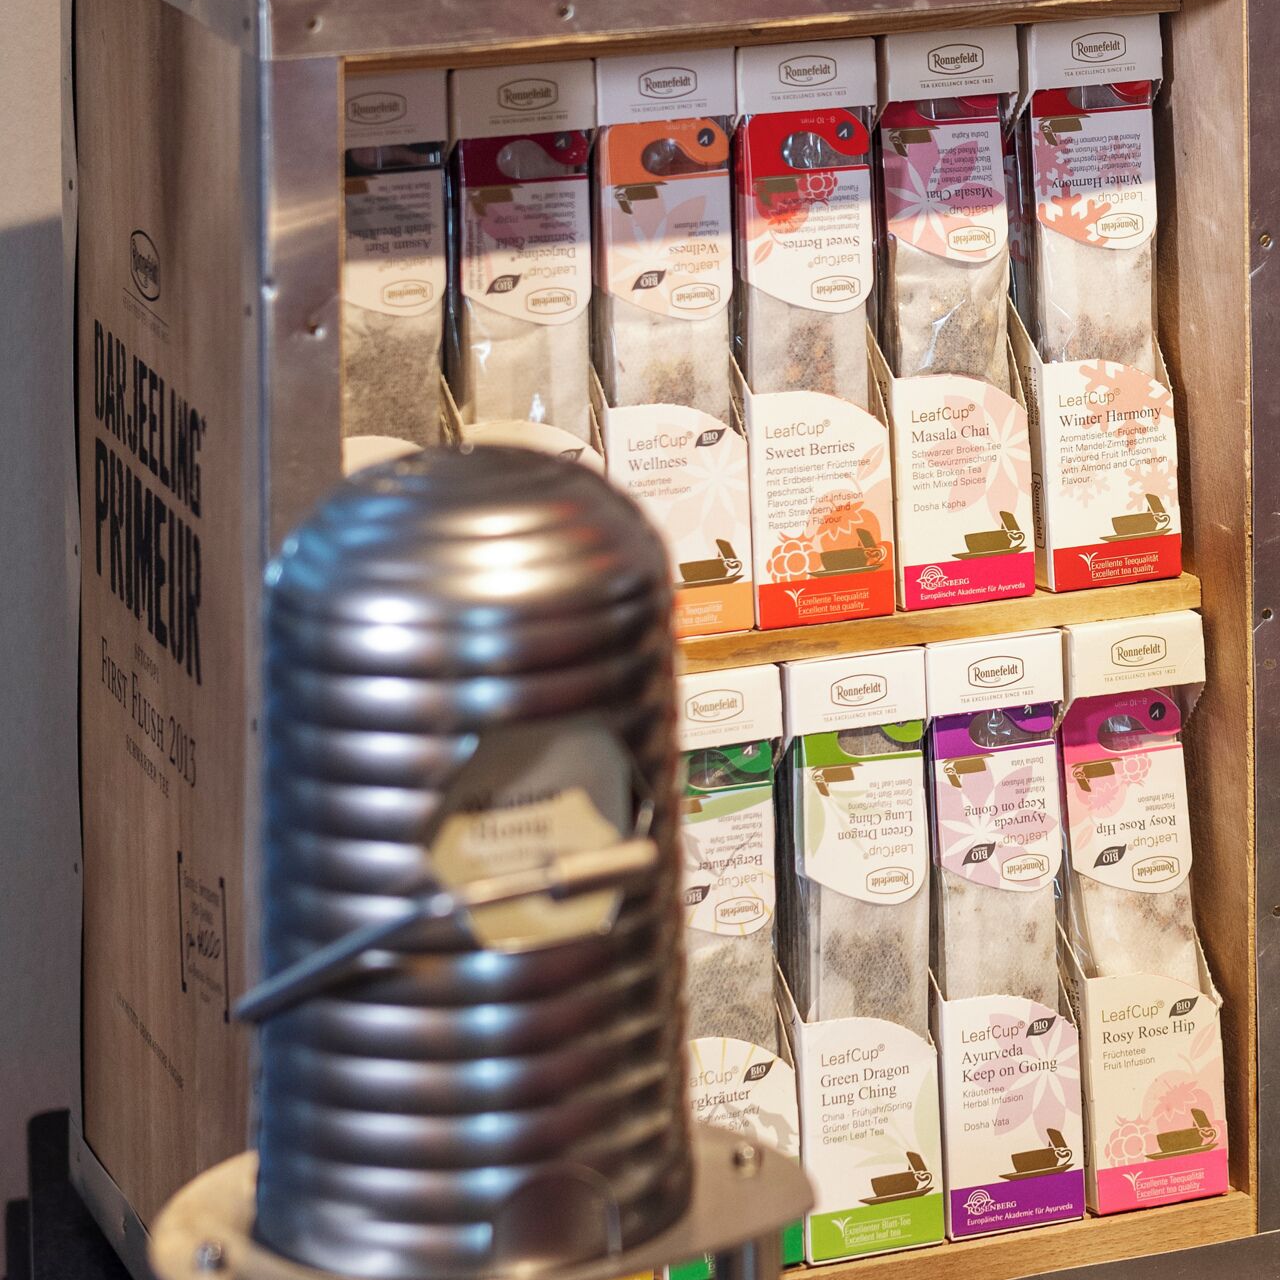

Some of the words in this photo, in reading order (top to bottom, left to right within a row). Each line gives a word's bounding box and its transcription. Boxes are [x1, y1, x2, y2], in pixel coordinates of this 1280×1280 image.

[1076, 41, 1120, 56] Ronnefeldt
[934, 52, 978, 68] Ronnefeldt
[784, 63, 831, 79] Ronnefeldt
[645, 77, 691, 91] Ronnefeldt
[1052, 177, 1102, 189] Harmony
[1104, 174, 1142, 186] Winter
[926, 189, 952, 203] Chai
[955, 187, 993, 200] Masala
[1101, 218, 1139, 232] Ronnefeldt
[783, 238, 823, 252] Berries
[825, 235, 860, 247] Sweet
[668, 243, 719, 256] Wellness
[641, 277, 658, 287] BIO
[816, 282, 856, 295] Ronnefeldt
[1059, 413, 1103, 427] Winter
[1105, 407, 1162, 423] Harmony
[703, 432, 719, 442] BIO
[912, 427, 957, 443] Masala
[960, 423, 990, 439] Chai
[1060, 430, 1115, 442] Aromatisierter
[766, 447, 805, 461] Sweet
[809, 440, 856, 456] Berries
[912, 448, 954, 459] Schwarzer
[956, 445, 985, 455] Broken
[986, 443, 1002, 452] Tee
[1061, 445, 1073, 454] mit
[1061, 454, 1100, 464] Flavoured
[1101, 450, 1119, 459] Fruit
[1121, 447, 1152, 457] Infusion
[628, 457, 688, 472] Wellness
[766, 464, 825, 475] Aromatisierter
[912, 461, 925, 470] mit
[1061, 466, 1079, 475] with
[1081, 461, 1111, 472] Almond
[1113, 459, 1127, 469] and
[1129, 455, 1168, 467] Cinnamon
[912, 471, 933, 480] Black
[936, 468, 965, 479] Broken
[967, 465, 982, 474] Tea
[767, 478, 781, 487] mit
[913, 482, 930, 491] with
[932, 478, 957, 489] Mixed
[960, 476, 987, 487] Spices
[767, 498, 808, 509] Flavoured
[810, 495, 829, 504] Fruit
[831, 491, 864, 502] Infusion
[913, 502, 939, 512] Dosha
[941, 500, 966, 510] Kapha
[768, 509, 786, 519] with
[788, 505, 833, 518] Strawberry
[836, 501, 851, 511] and
[95, 436, 201, 687] PRIMEUR
[957, 586, 987, 597] Akademie
[997, 582, 1026, 593] Ayurveda
[1116, 643, 1161, 661] Ronnefeldt
[973, 664, 1018, 681] Ronnefeldt
[836, 682, 881, 700] Ronnefeldt
[102, 635, 128, 709] FIRST
[131, 671, 164, 753] FLUSH
[169, 715, 197, 788] 2013
[691, 697, 738, 716] Ronnefeldt
[126, 733, 157, 784] SCHWARZER
[964, 805, 999, 818] Going
[1001, 802, 1015, 813] on
[1017, 798, 1046, 812] Keep
[849, 813, 882, 827] Ching
[884, 810, 913, 823] Lung
[994, 811, 1047, 830] Ayurveda
[1149, 814, 1177, 827] Rosy
[881, 825, 913, 838] Green
[1096, 823, 1117, 837] Hip
[1119, 819, 1146, 832] Rose
[837, 827, 877, 841] Dragon
[698, 853, 763, 871] Bergkräuter
[971, 850, 988, 861] BIO
[1102, 853, 1119, 864] BIO
[1007, 859, 1045, 874] Ronnefeldt
[1137, 861, 1176, 877] Ronnefeldt
[871, 873, 910, 887] Ronnefeldt
[720, 903, 760, 918] Ronnefeldt
[1176, 1001, 1191, 1010] BIO
[1033, 1021, 1049, 1031] BIO
[1102, 1031, 1134, 1045] Rosy
[1138, 1025, 1169, 1039] Rose
[1173, 1019, 1195, 1035] Hip
[962, 1044, 1023, 1066] Ayurveda
[1102, 1047, 1146, 1060] Früchtetee
[750, 1065, 766, 1076] BIO
[962, 1069, 996, 1083] Keep
[999, 1065, 1015, 1077] on
[1019, 1058, 1057, 1074] Going
[1103, 1061, 1122, 1071] Fruit
[1123, 1056, 1156, 1068] Infusion
[820, 1073, 859, 1088] Green
[863, 1065, 910, 1081] Dragon
[822, 1092, 855, 1107] Lung
[858, 1084, 897, 1100] Ching
[962, 1086, 1005, 1099] Kräutertee
[963, 1097, 989, 1110] Herbal
[991, 1094, 1024, 1105] Infusion
[822, 1111, 845, 1123] China
[964, 1121, 990, 1132] Dosha
[991, 1117, 1010, 1128] Vata
[822, 1122, 850, 1134] Grüner
[852, 1116, 889, 1129] Blatt-Tee
[822, 1134, 848, 1145] Green
[849, 1129, 867, 1141] Leaf
[870, 1127, 885, 1137] Tea
[967, 1200, 1017, 1215] ROSENBERG
[967, 1213, 1004, 1226] Europäische
[1004, 1208, 1035, 1220] Akademie
[1035, 1206, 1045, 1215] für
[1045, 1202, 1073, 1215] Ayurveda
